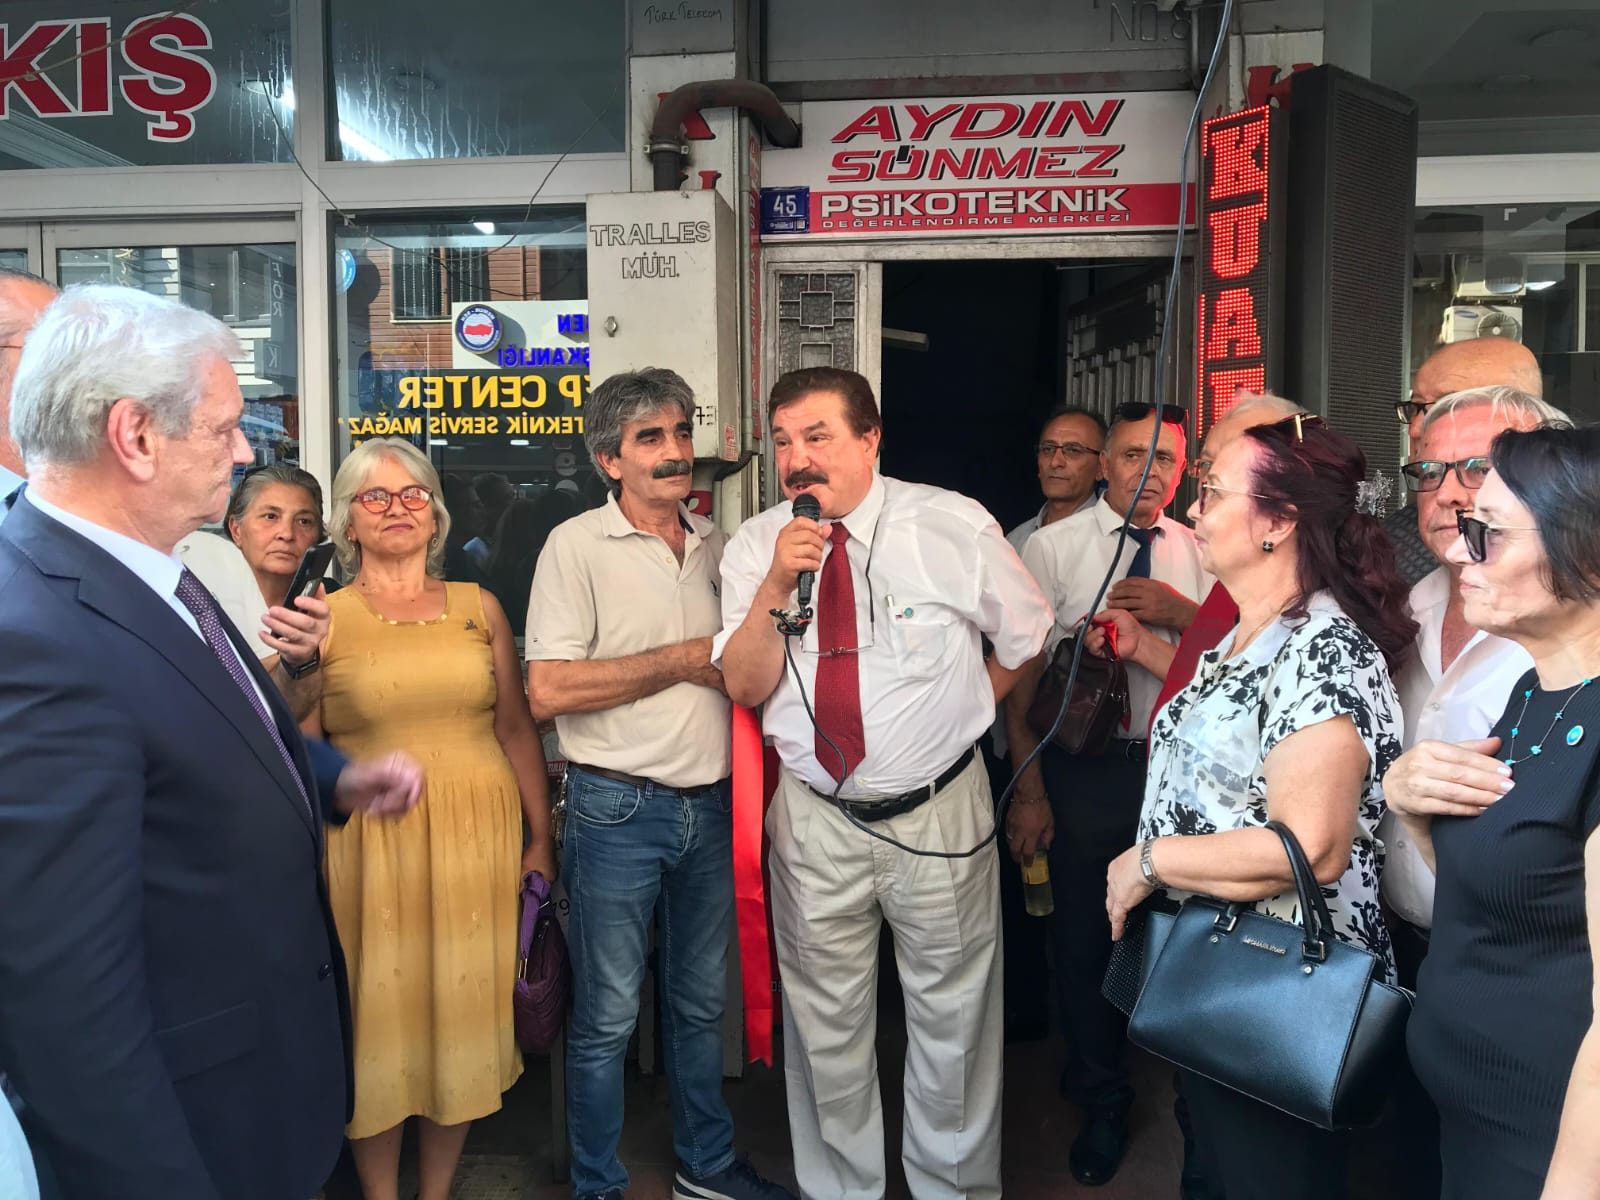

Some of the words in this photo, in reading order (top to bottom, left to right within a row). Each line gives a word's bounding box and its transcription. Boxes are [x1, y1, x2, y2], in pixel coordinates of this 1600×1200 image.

[830, 99, 1126, 143] AYDIN
[773, 194, 797, 215] 45
[822, 214, 1013, 228] DEĞERLENDİRME
[1029, 212, 1130, 224] MERKEZİ
[590, 221, 711, 246] TRALLES
[622, 251, 680, 279] MÜH.
